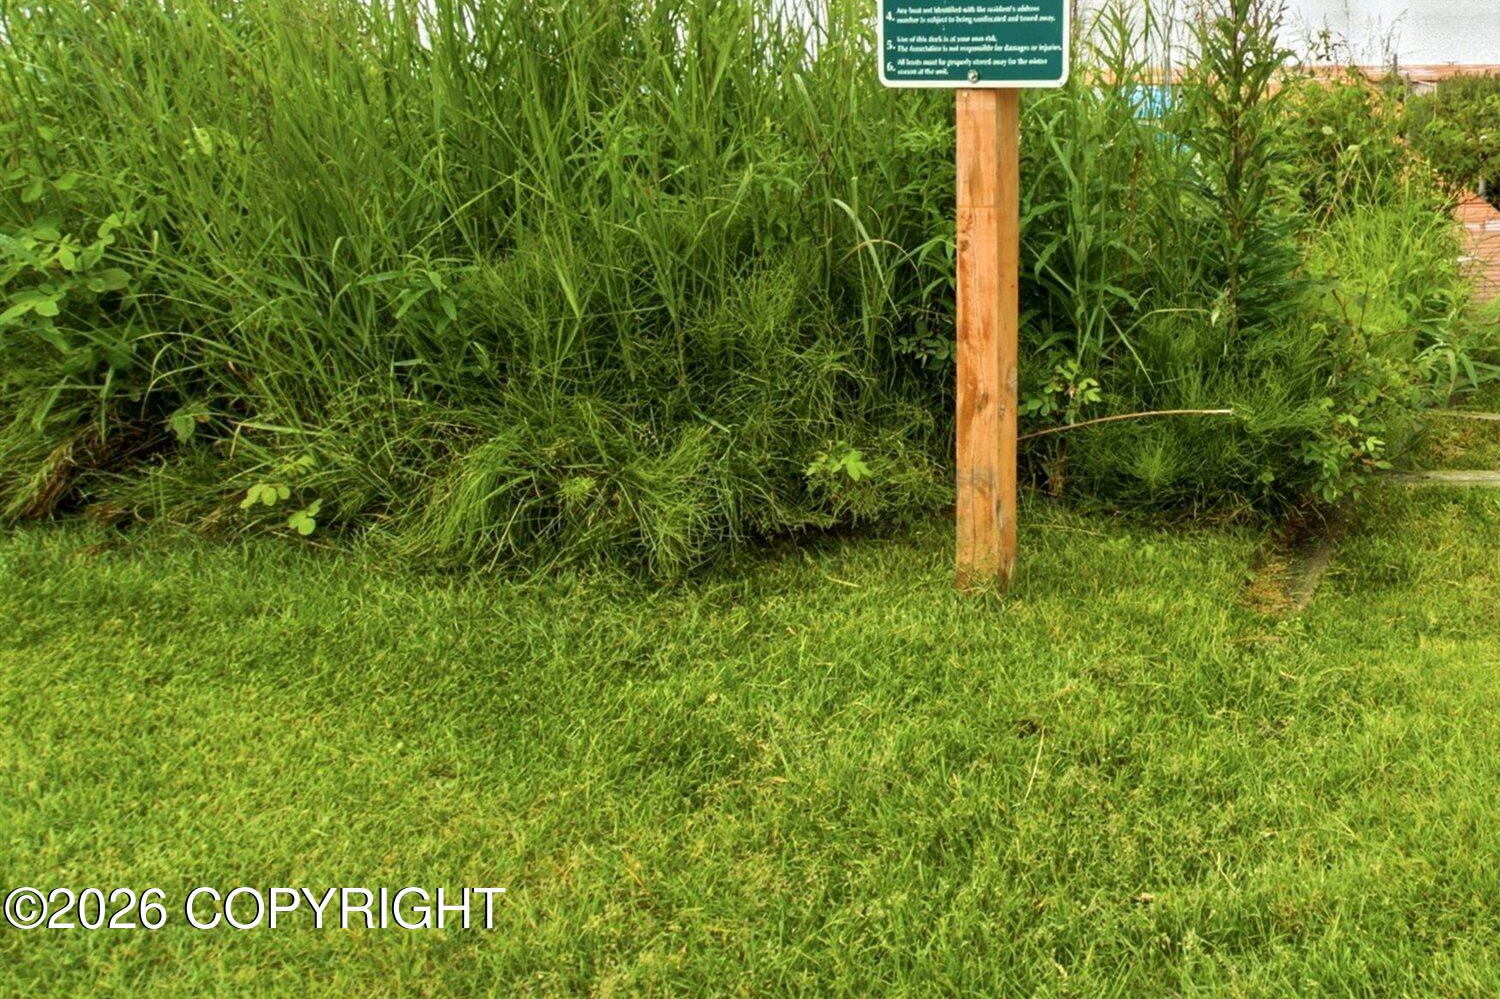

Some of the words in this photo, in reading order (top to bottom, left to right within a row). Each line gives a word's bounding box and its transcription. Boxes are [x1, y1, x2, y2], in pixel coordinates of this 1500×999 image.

[886, 11, 895, 21] 4.
[886, 40, 895, 50] 5.
[887, 62, 896, 71] 6.
